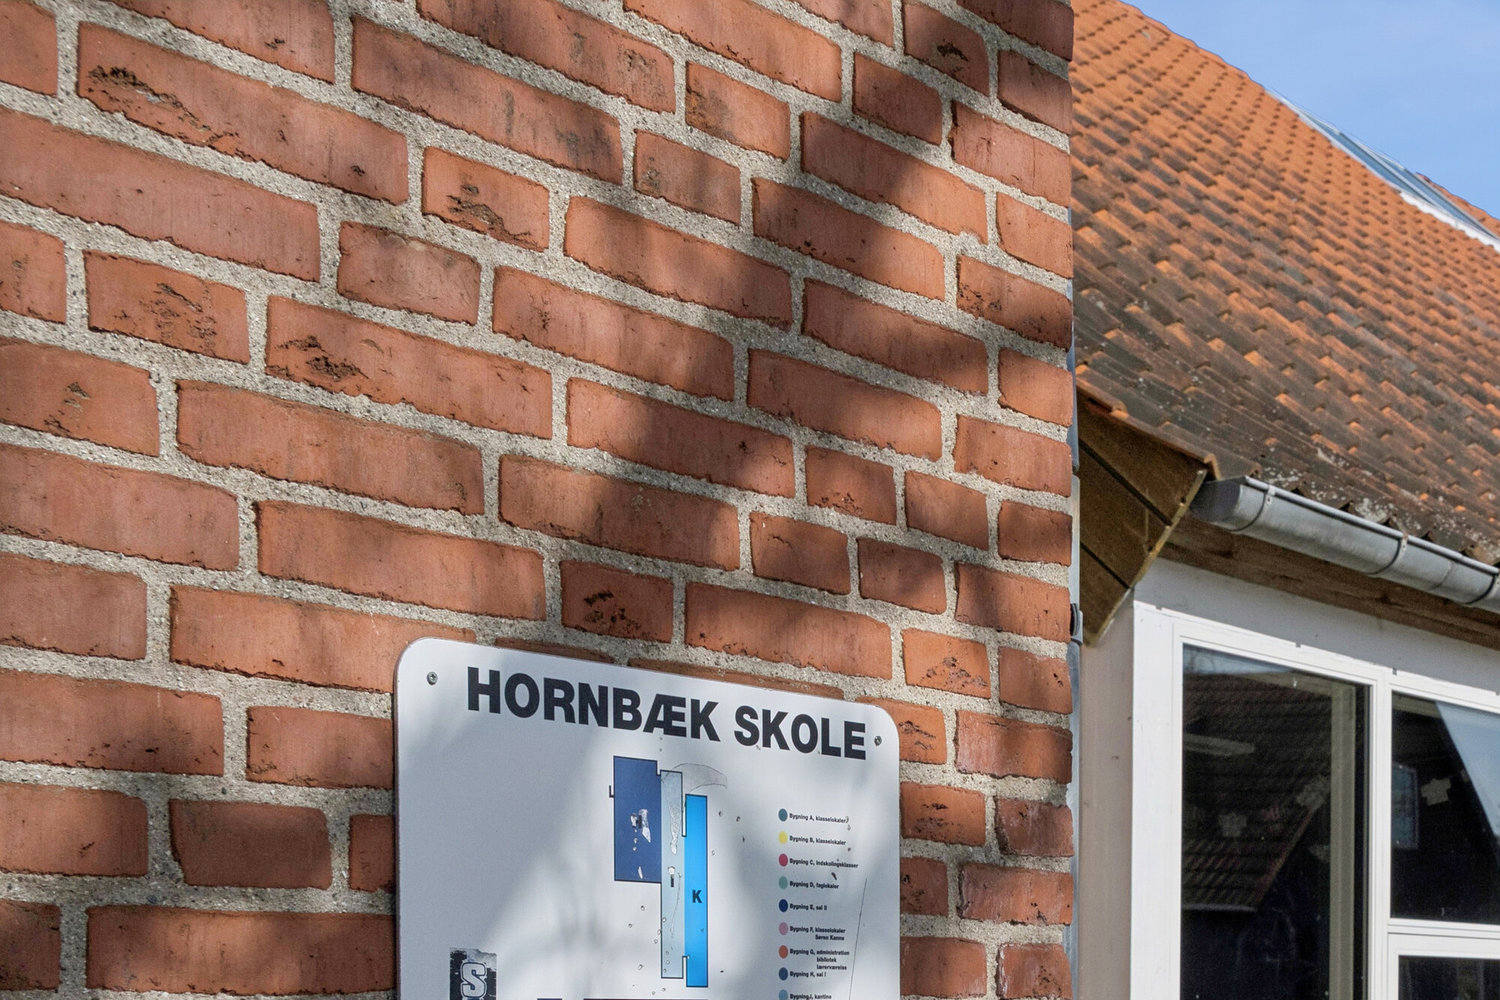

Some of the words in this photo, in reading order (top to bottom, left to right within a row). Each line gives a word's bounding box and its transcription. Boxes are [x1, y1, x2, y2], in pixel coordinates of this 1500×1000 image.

[467, 666, 721, 742] HORNBÆK
[734, 705, 867, 761] SKOLE
[692, 889, 702, 904] K
